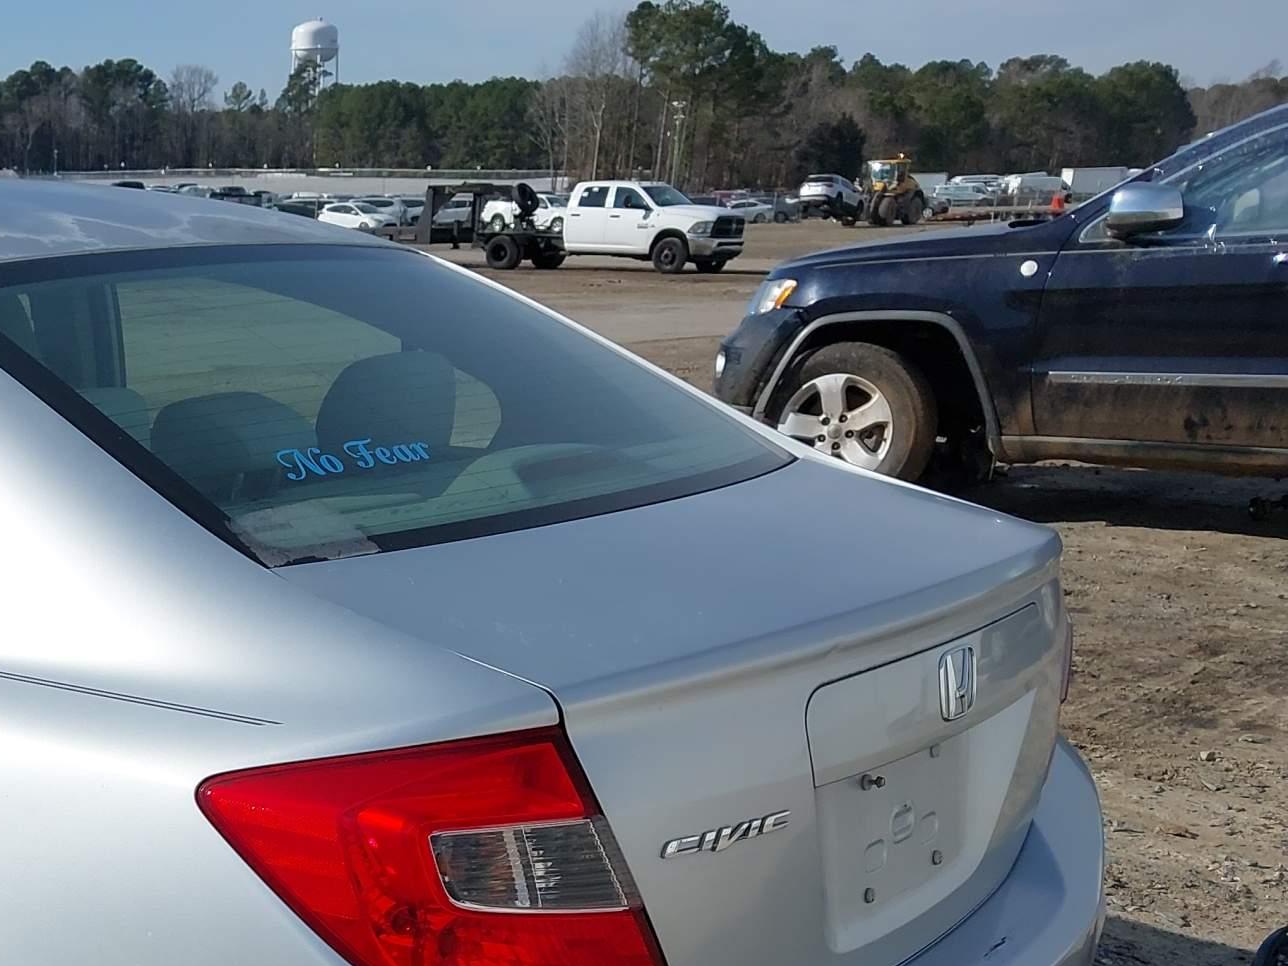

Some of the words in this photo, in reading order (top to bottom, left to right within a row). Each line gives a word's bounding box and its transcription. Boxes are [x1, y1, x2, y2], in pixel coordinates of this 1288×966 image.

[276, 447, 344, 481] No
[343, 438, 429, 469] Fear
[660, 809, 791, 859] CIVIC
